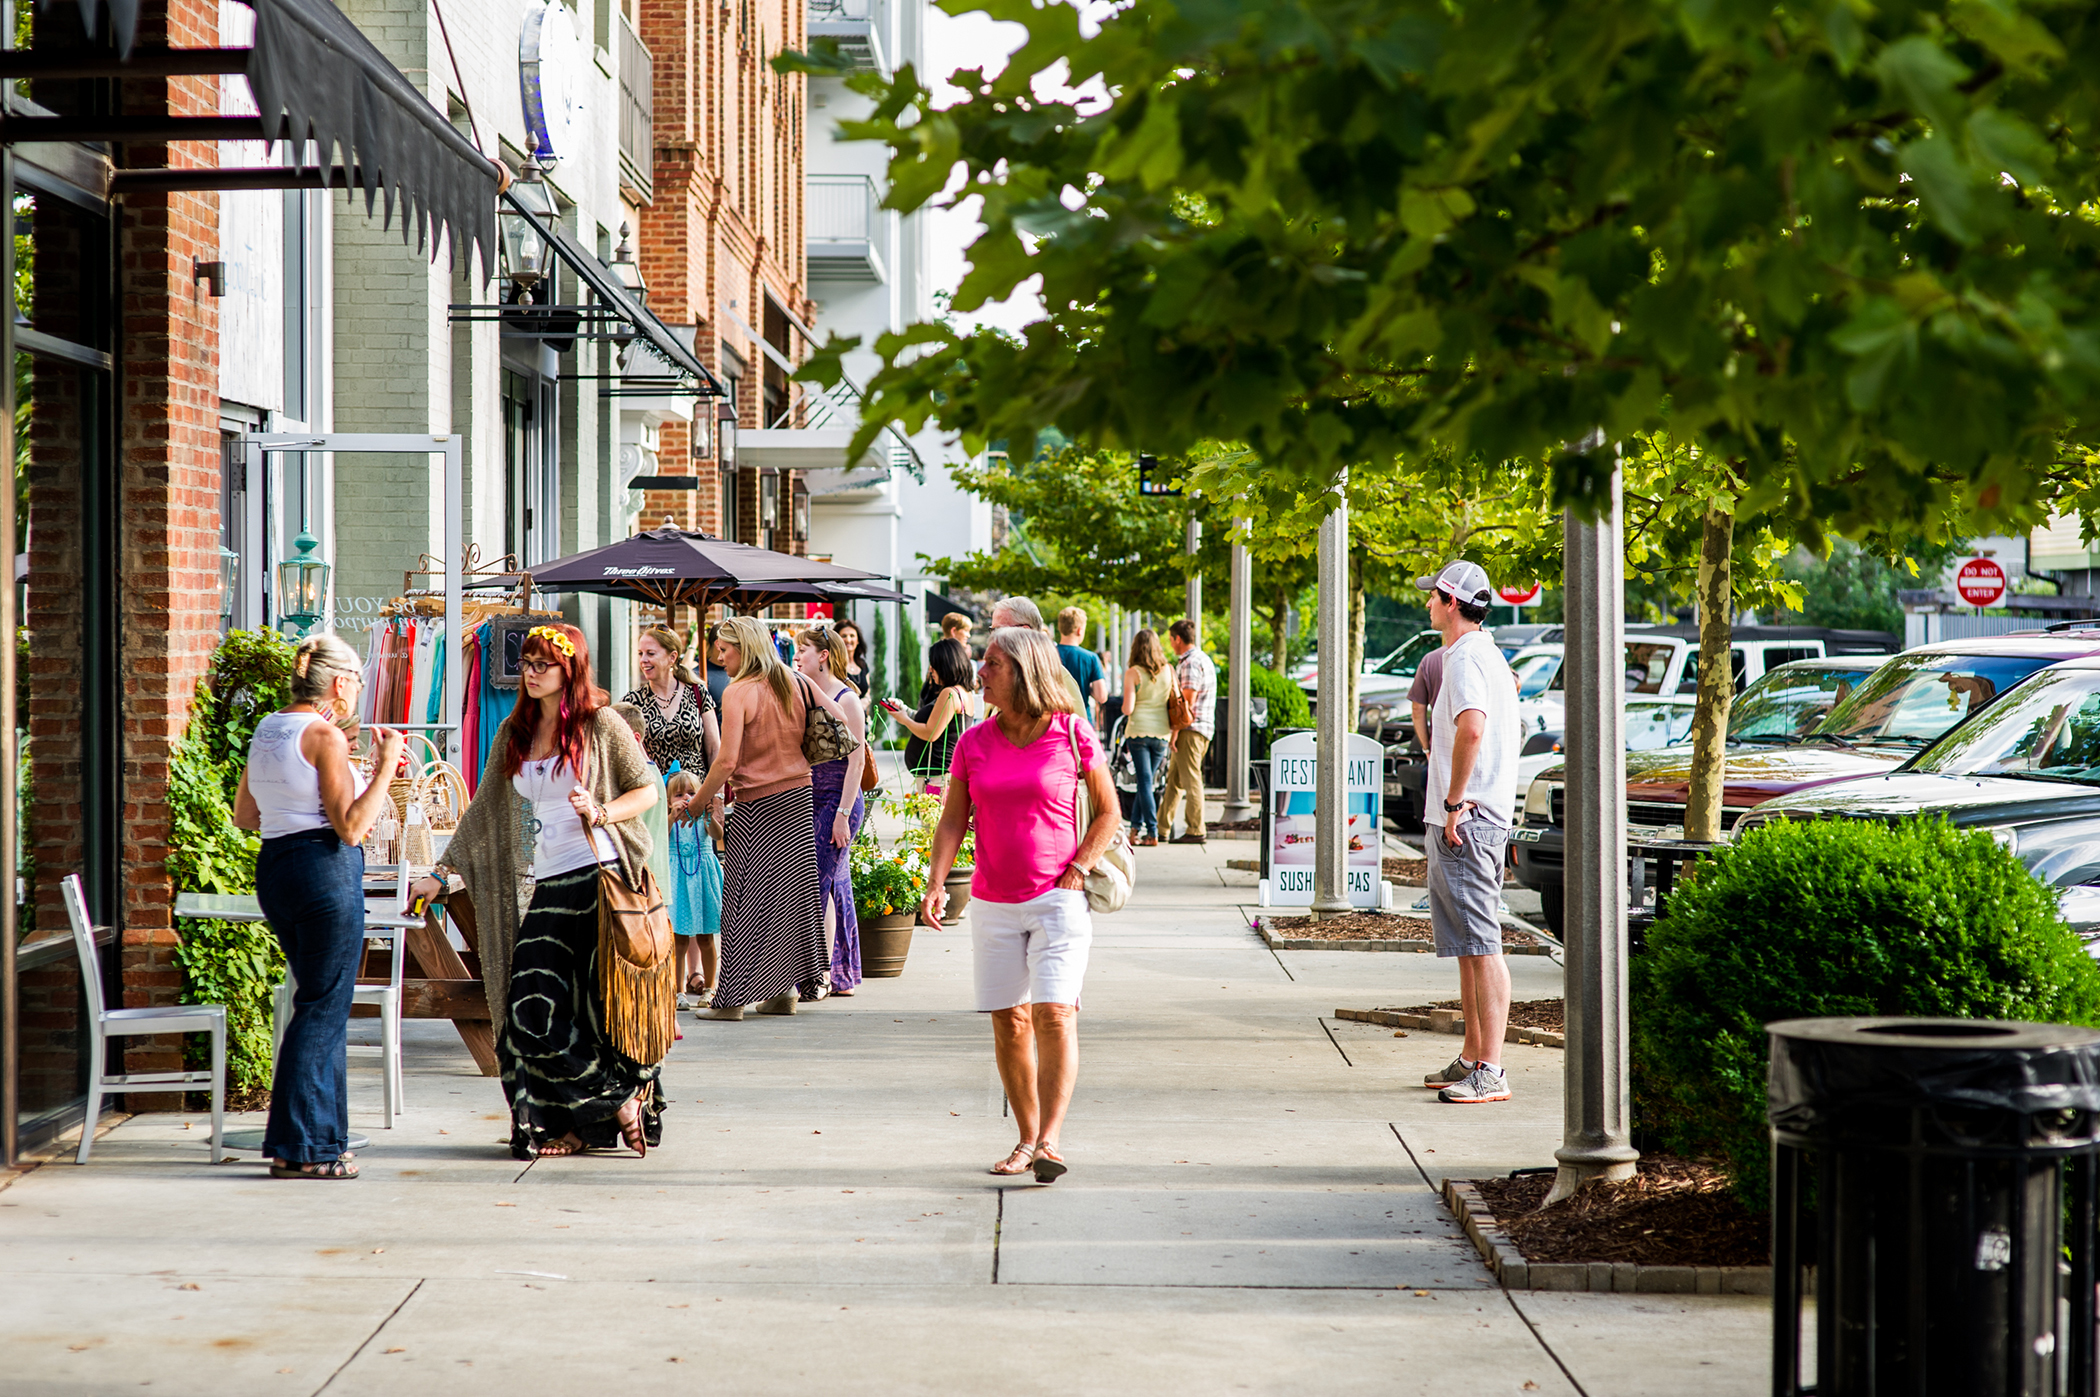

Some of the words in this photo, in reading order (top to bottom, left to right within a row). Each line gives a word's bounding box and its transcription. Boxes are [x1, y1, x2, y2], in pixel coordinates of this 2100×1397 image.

[603, 566, 637, 576] Three
[1964, 566, 1977, 577] DO
[1980, 566, 1998, 577] NOT
[1967, 588, 1995, 598] ENTER
[1281, 759, 1375, 785] RESTANT
[1348, 872, 1370, 892] PAS
